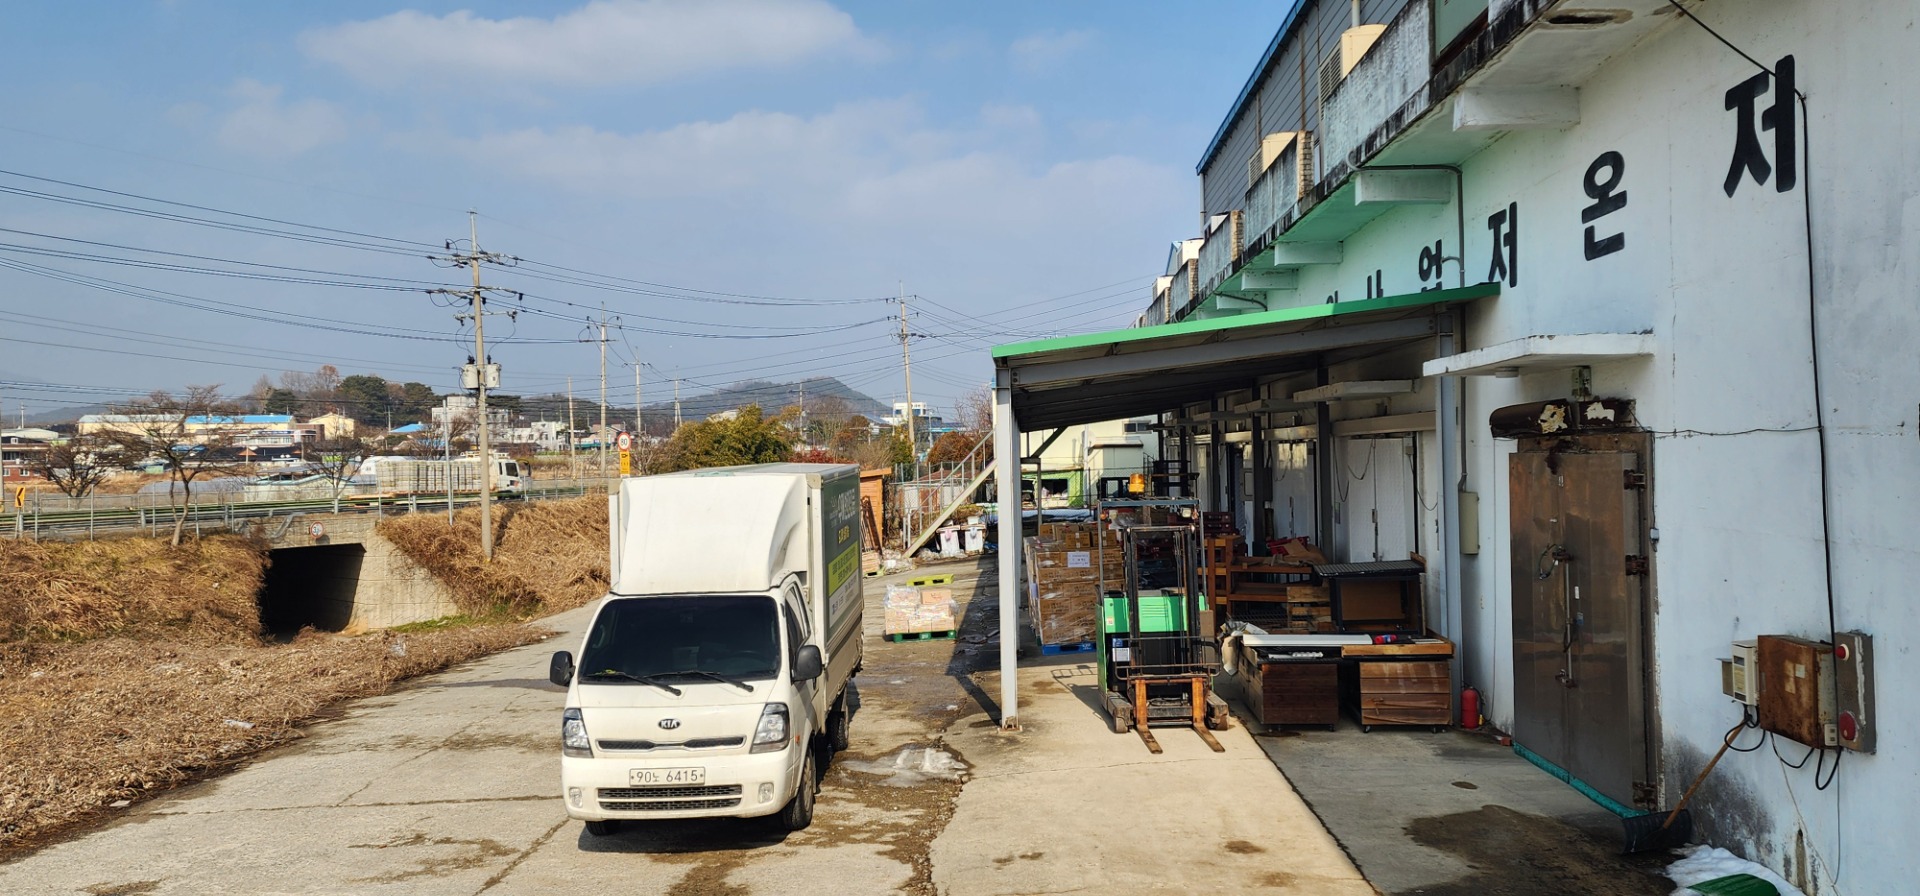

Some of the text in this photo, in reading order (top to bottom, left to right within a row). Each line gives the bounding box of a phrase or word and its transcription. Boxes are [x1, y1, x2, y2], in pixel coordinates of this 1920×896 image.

[661, 720, 678, 729] KIA
[636, 769, 698, 783] 90노 6415
